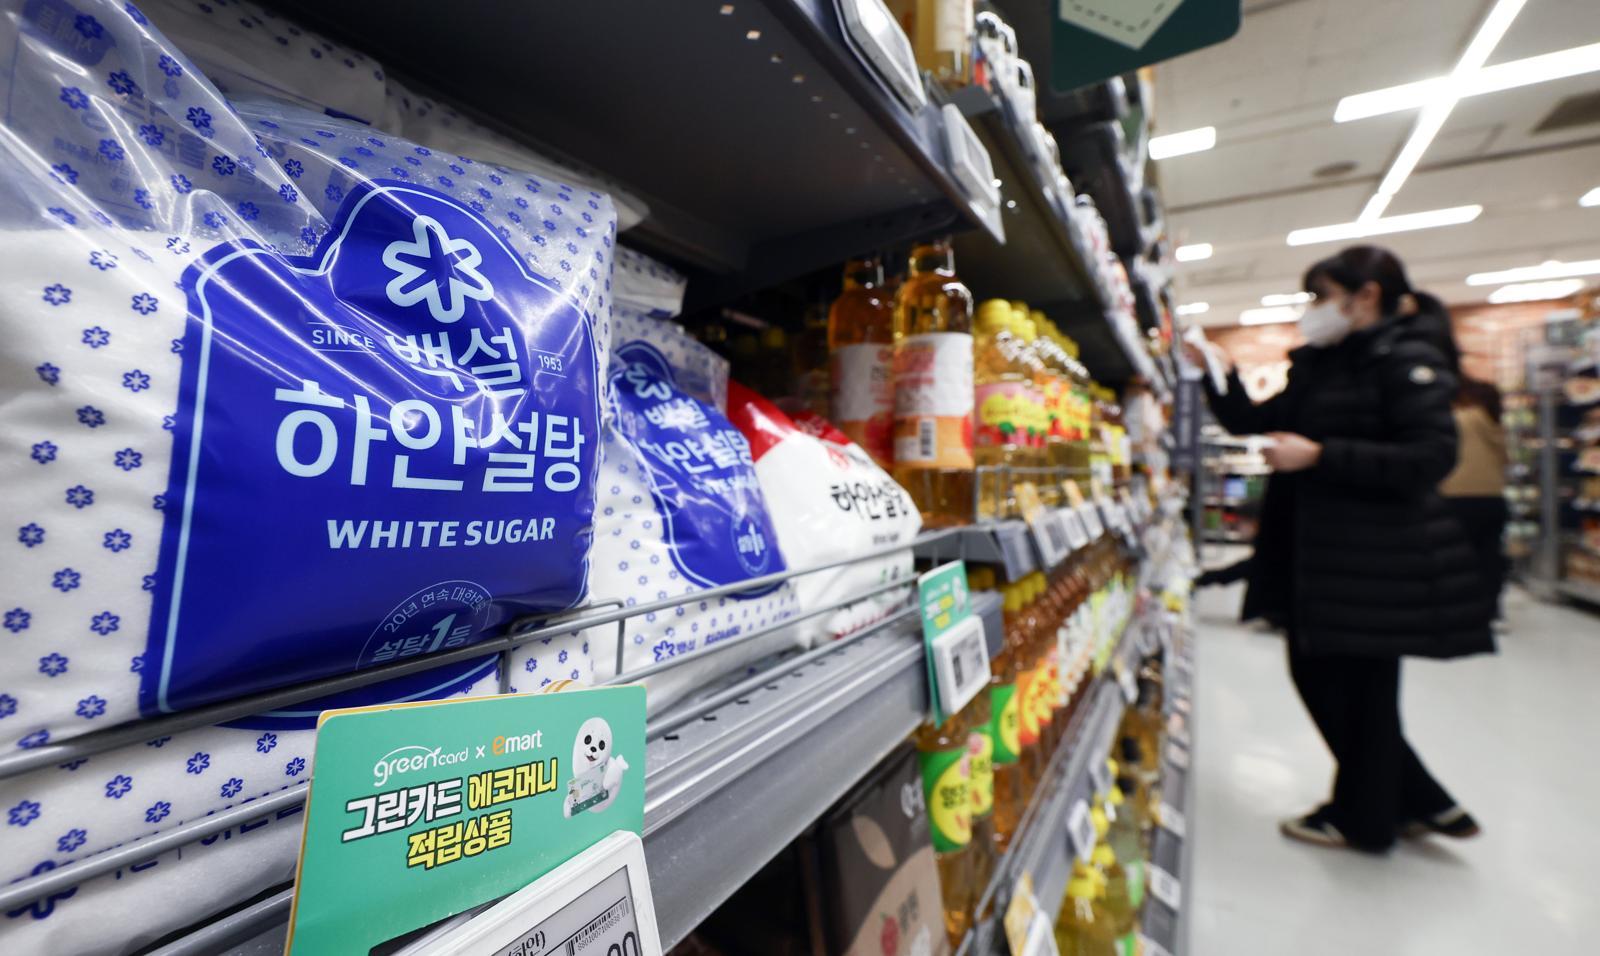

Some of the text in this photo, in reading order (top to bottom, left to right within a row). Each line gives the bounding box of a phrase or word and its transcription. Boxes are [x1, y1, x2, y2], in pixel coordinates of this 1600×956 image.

[312, 329, 376, 349] SINCE
[385, 327, 527, 399] 백설
[538, 354, 563, 373] 1953
[274, 379, 585, 492] 하얀설탕
[327, 517, 556, 549] WHITE SUGAR
[384, 602, 421, 633] 20년
[421, 588, 450, 608] 연속
[491, 729, 543, 756] emart
[341, 777, 463, 844] 그린카드
[467, 756, 559, 810] 에코머니
[406, 808, 513, 871] 적립상품
